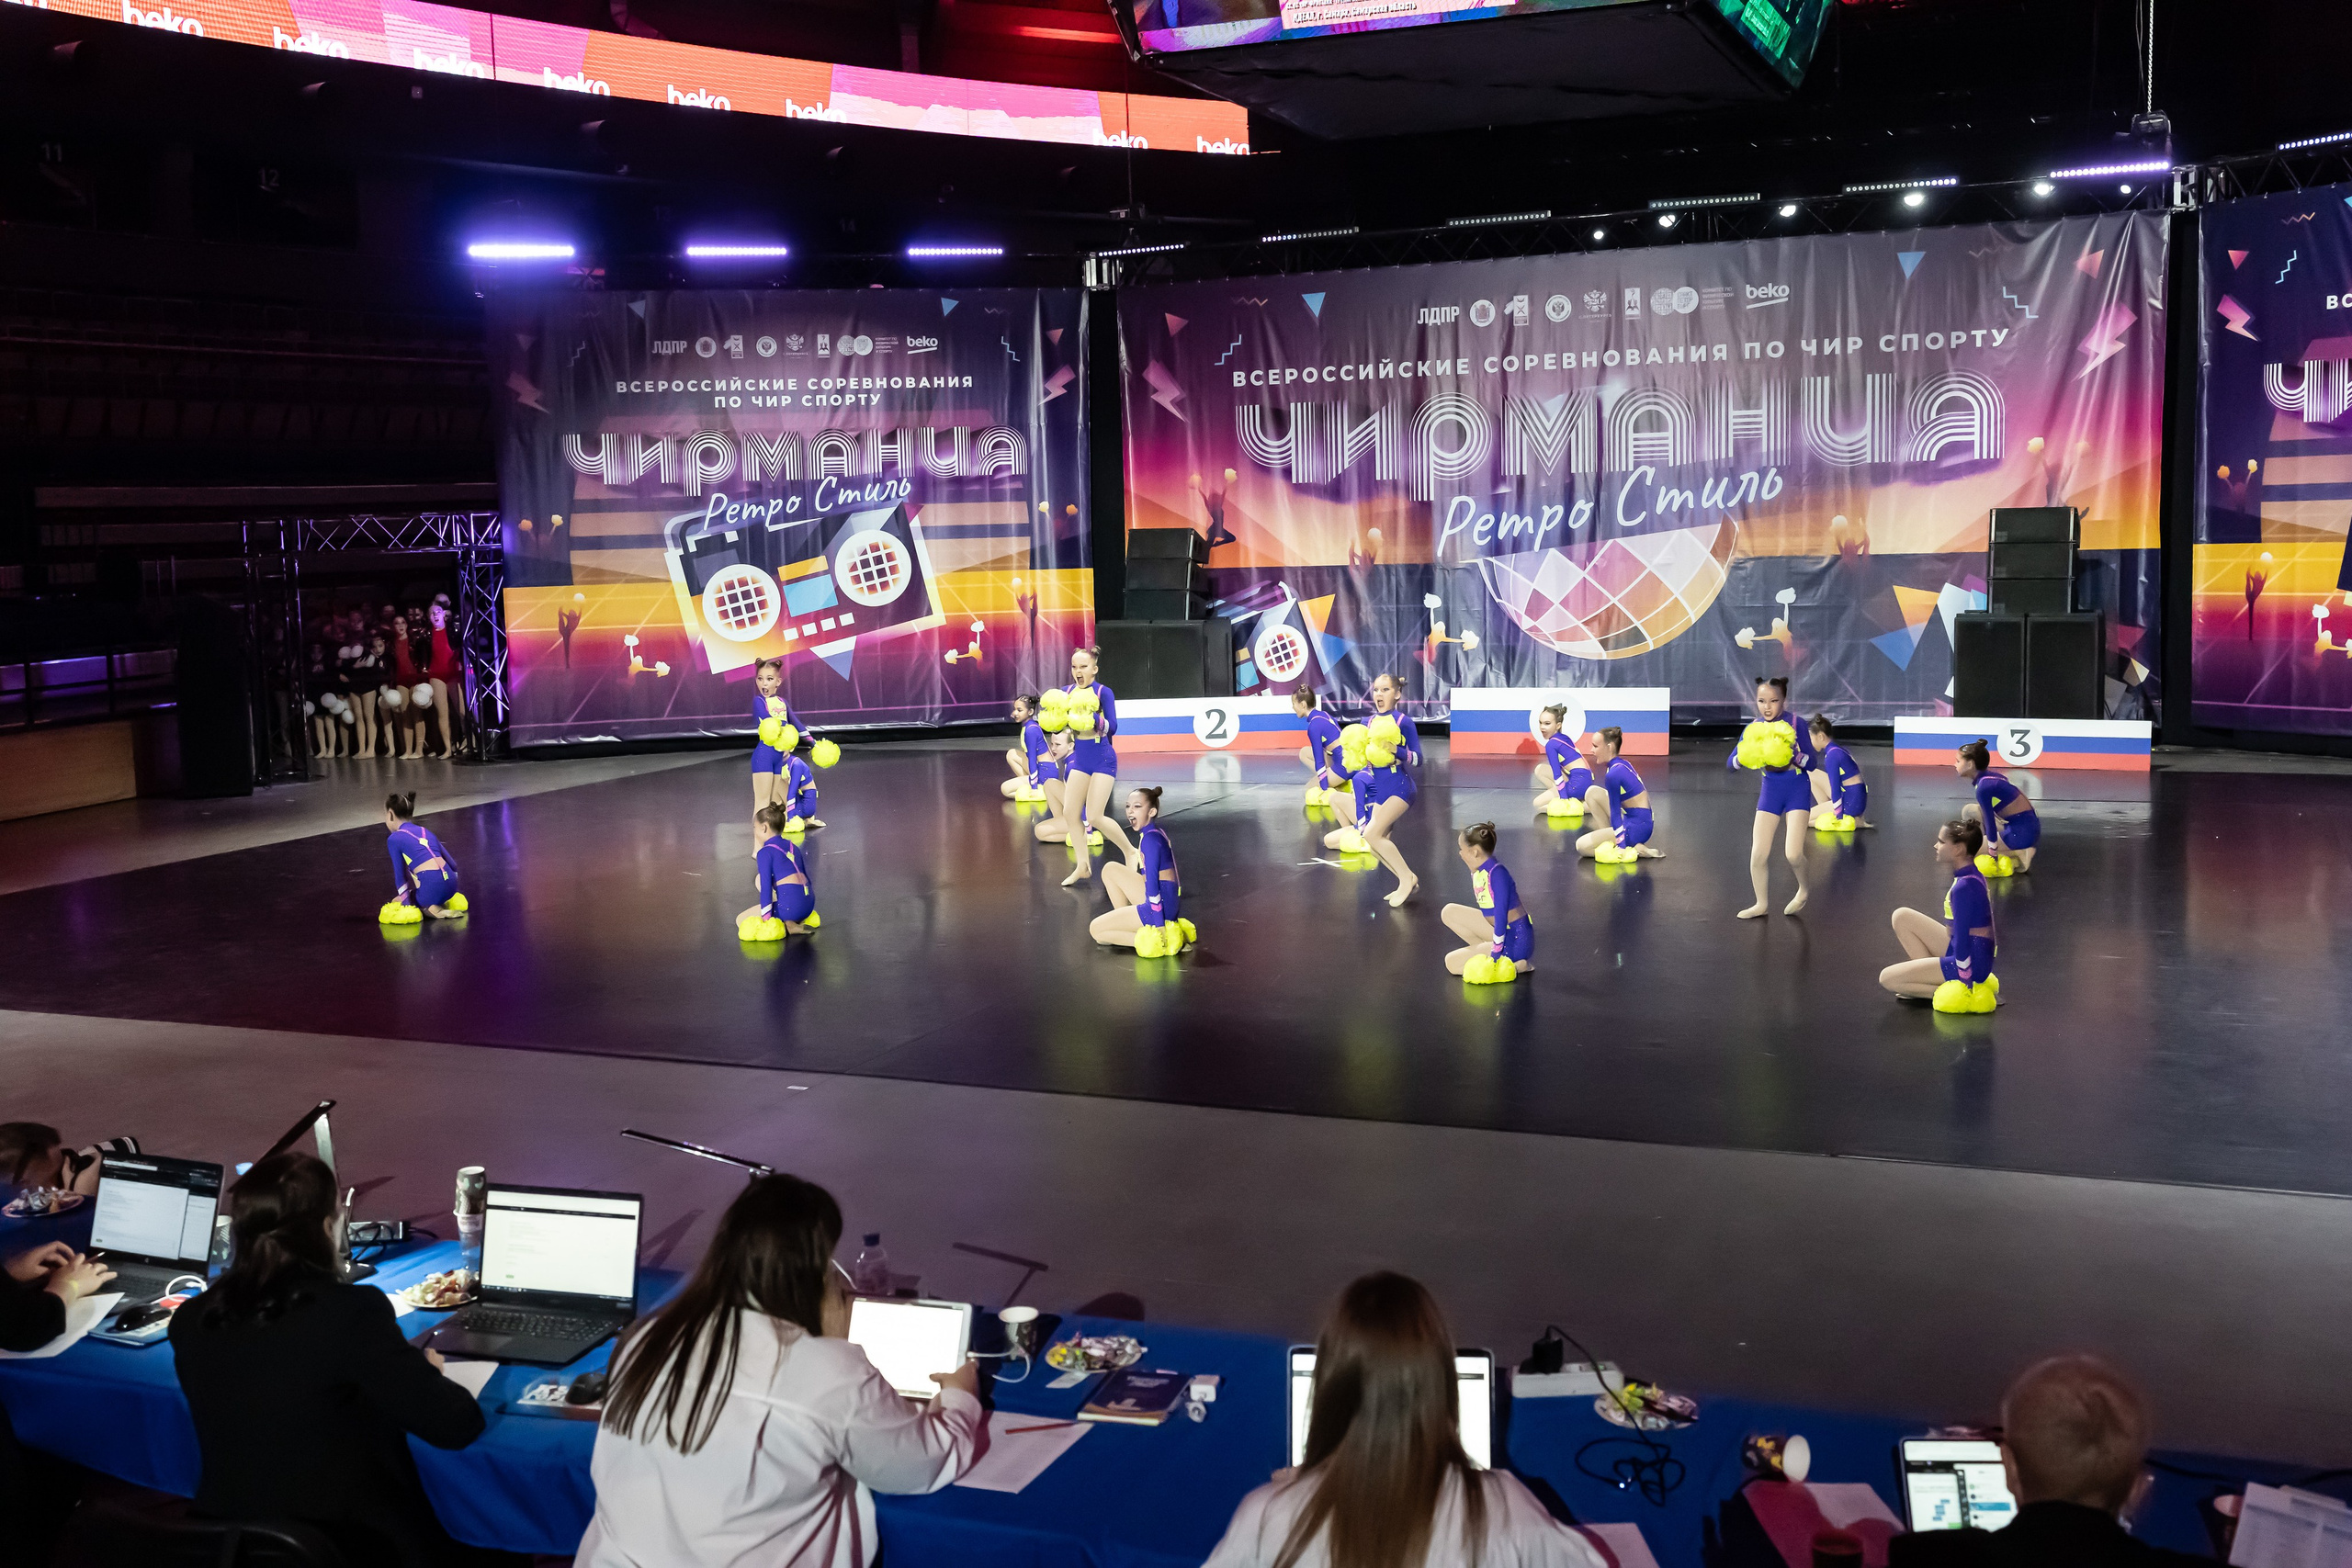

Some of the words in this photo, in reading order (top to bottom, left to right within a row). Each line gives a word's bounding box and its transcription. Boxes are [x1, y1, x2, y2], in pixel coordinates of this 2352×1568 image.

[258, 167, 280, 187] 12
[1746, 283, 1790, 299] beko
[1418, 306, 1460, 326] ЛДПР
[651, 340, 687, 355] ЛДПР
[907, 335, 938, 347] beko
[1233, 357, 1470, 387] ВСЕРОССИЙСКИЕ
[1483, 344, 1728, 374] СОРЕВНОВАНИЯ
[1745, 341, 1785, 359] ПО
[1801, 336, 1863, 356] ЧИР
[1879, 328, 2009, 353] СПОРТУ
[616, 377, 797, 393] ВСЕРОССИЙСКИЕ
[807, 376, 973, 390] СОРЕВНОВАНИЯ
[714, 396, 741, 408] ПО
[752, 395, 792, 407] ЧИР
[801, 393, 881, 407] СПОРТУ
[703, 492, 802, 532] Ретро
[815, 475, 911, 512] Стиль
[1437, 495, 1595, 557] Ретро
[1616, 465, 1784, 526] Стиль
[1204, 708, 1227, 739] 2
[2008, 728, 2031, 758] 3
